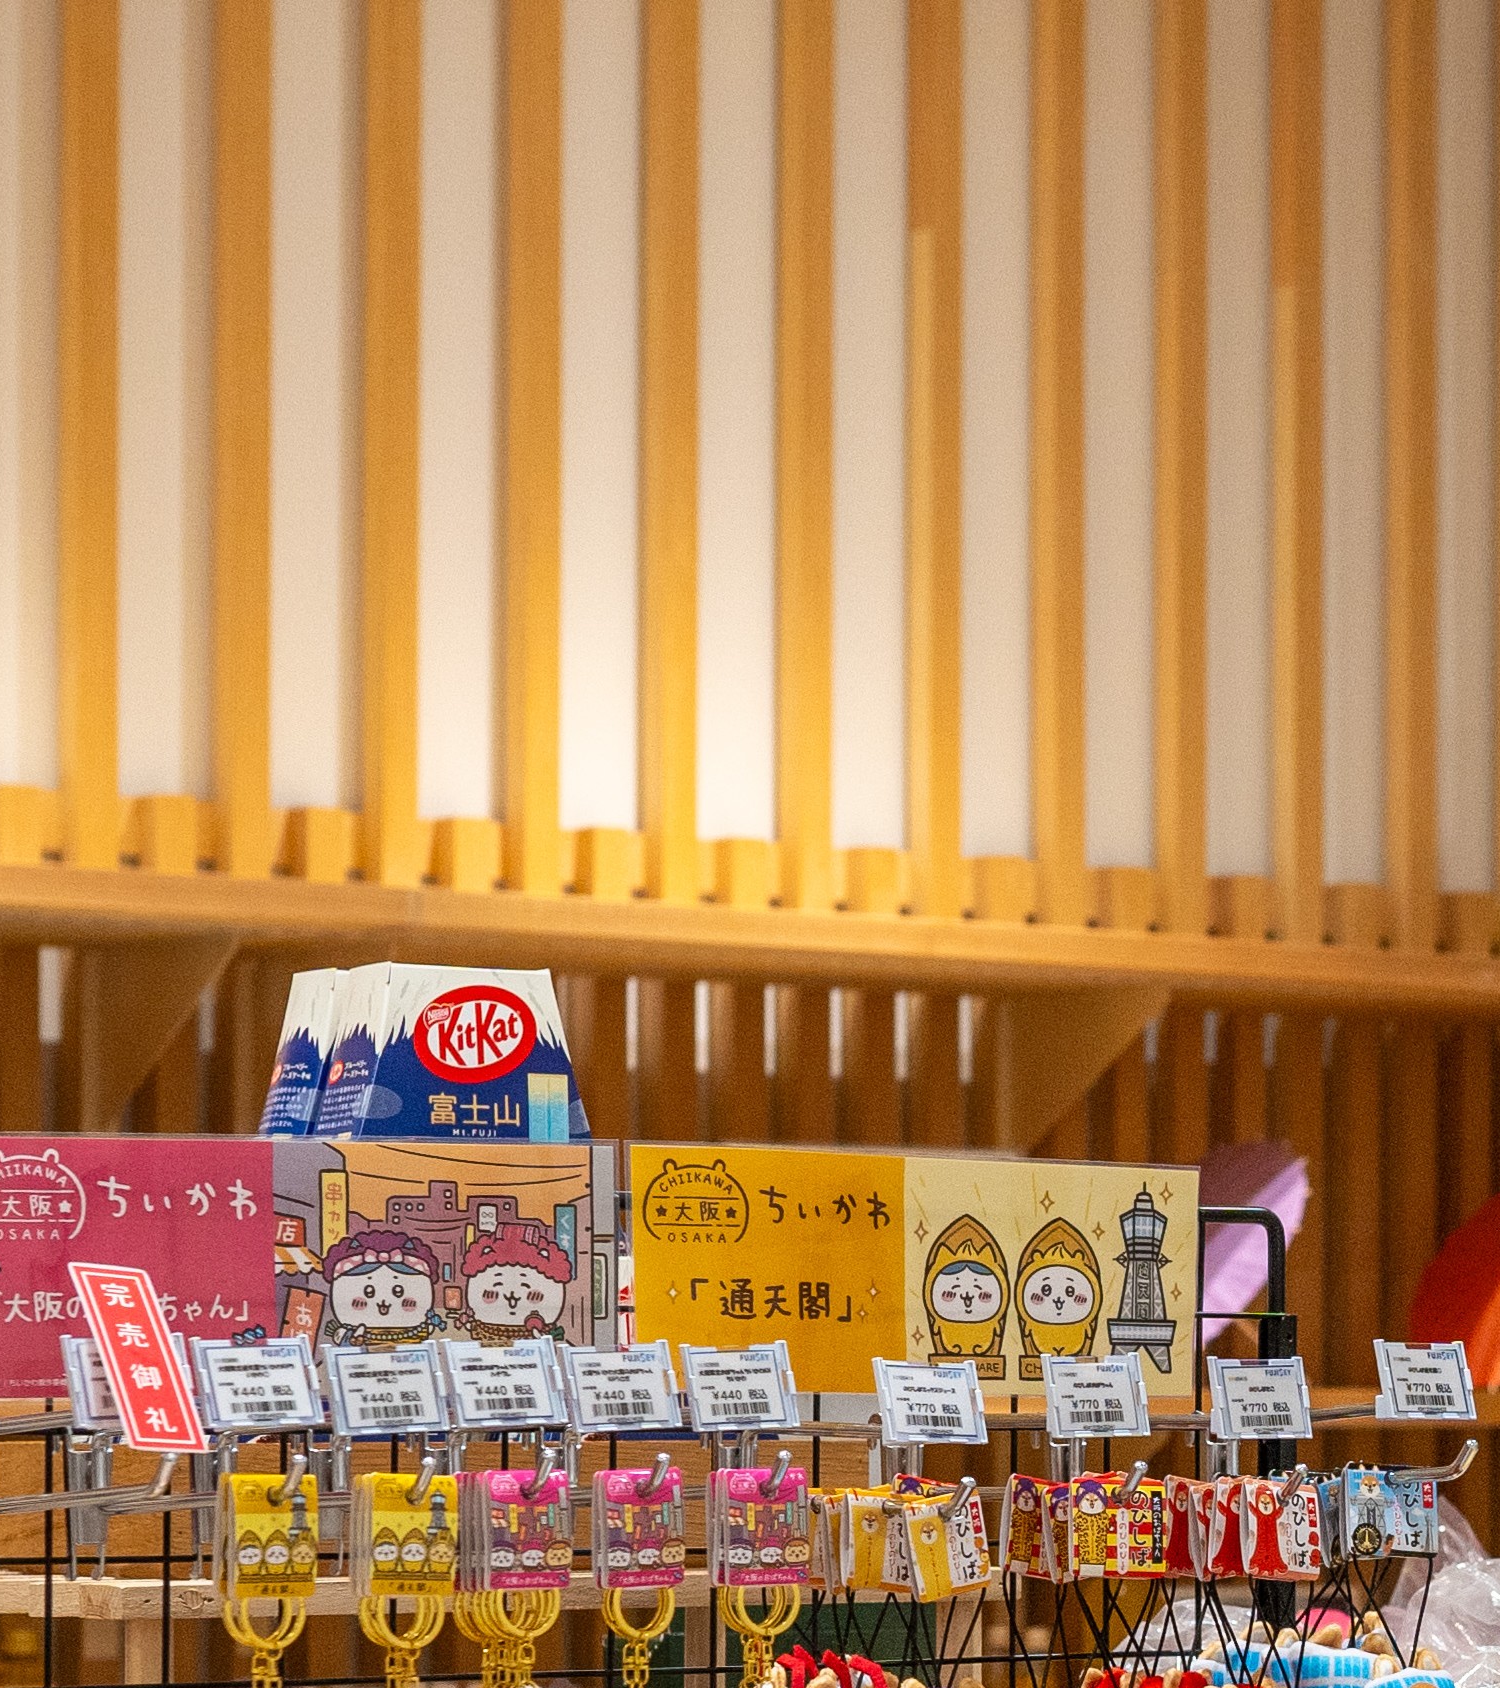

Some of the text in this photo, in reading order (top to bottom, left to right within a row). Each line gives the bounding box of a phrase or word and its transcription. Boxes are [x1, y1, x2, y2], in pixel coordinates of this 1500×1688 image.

[438, 1002, 519, 1066] KitKat
[429, 1093, 520, 1126] 富士山
[659, 1172, 734, 1195] CHIIKAWA
[1, 1195, 52, 1217] 大阪
[96, 1175, 258, 1220] ちいかわ
[759, 1185, 891, 1230] ちいかわ
[675, 1201, 720, 1222] 大阪
[276, 1219, 298, 1243] 店
[667, 1232, 727, 1243] OSAKA
[691, 1278, 852, 1322] 「通天閣」
[100, 1283, 178, 1433] 完売御礼
[232, 1385, 265, 1397] ¥440
[360, 1392, 394, 1404] ¥440
[475, 1385, 508, 1396] ¥440
[593, 1389, 625, 1401] ¥440
[711, 1389, 743, 1400] ¥440
[1406, 1382, 1431, 1393] ¥770
[907, 1402, 936, 1414] ¥770
[1071, 1399, 1100, 1410] ¥770
[1241, 1402, 1268, 1413] ¥770
[1131, 1490, 1152, 1568] のびしば
[1291, 1493, 1309, 1568] のびしば
